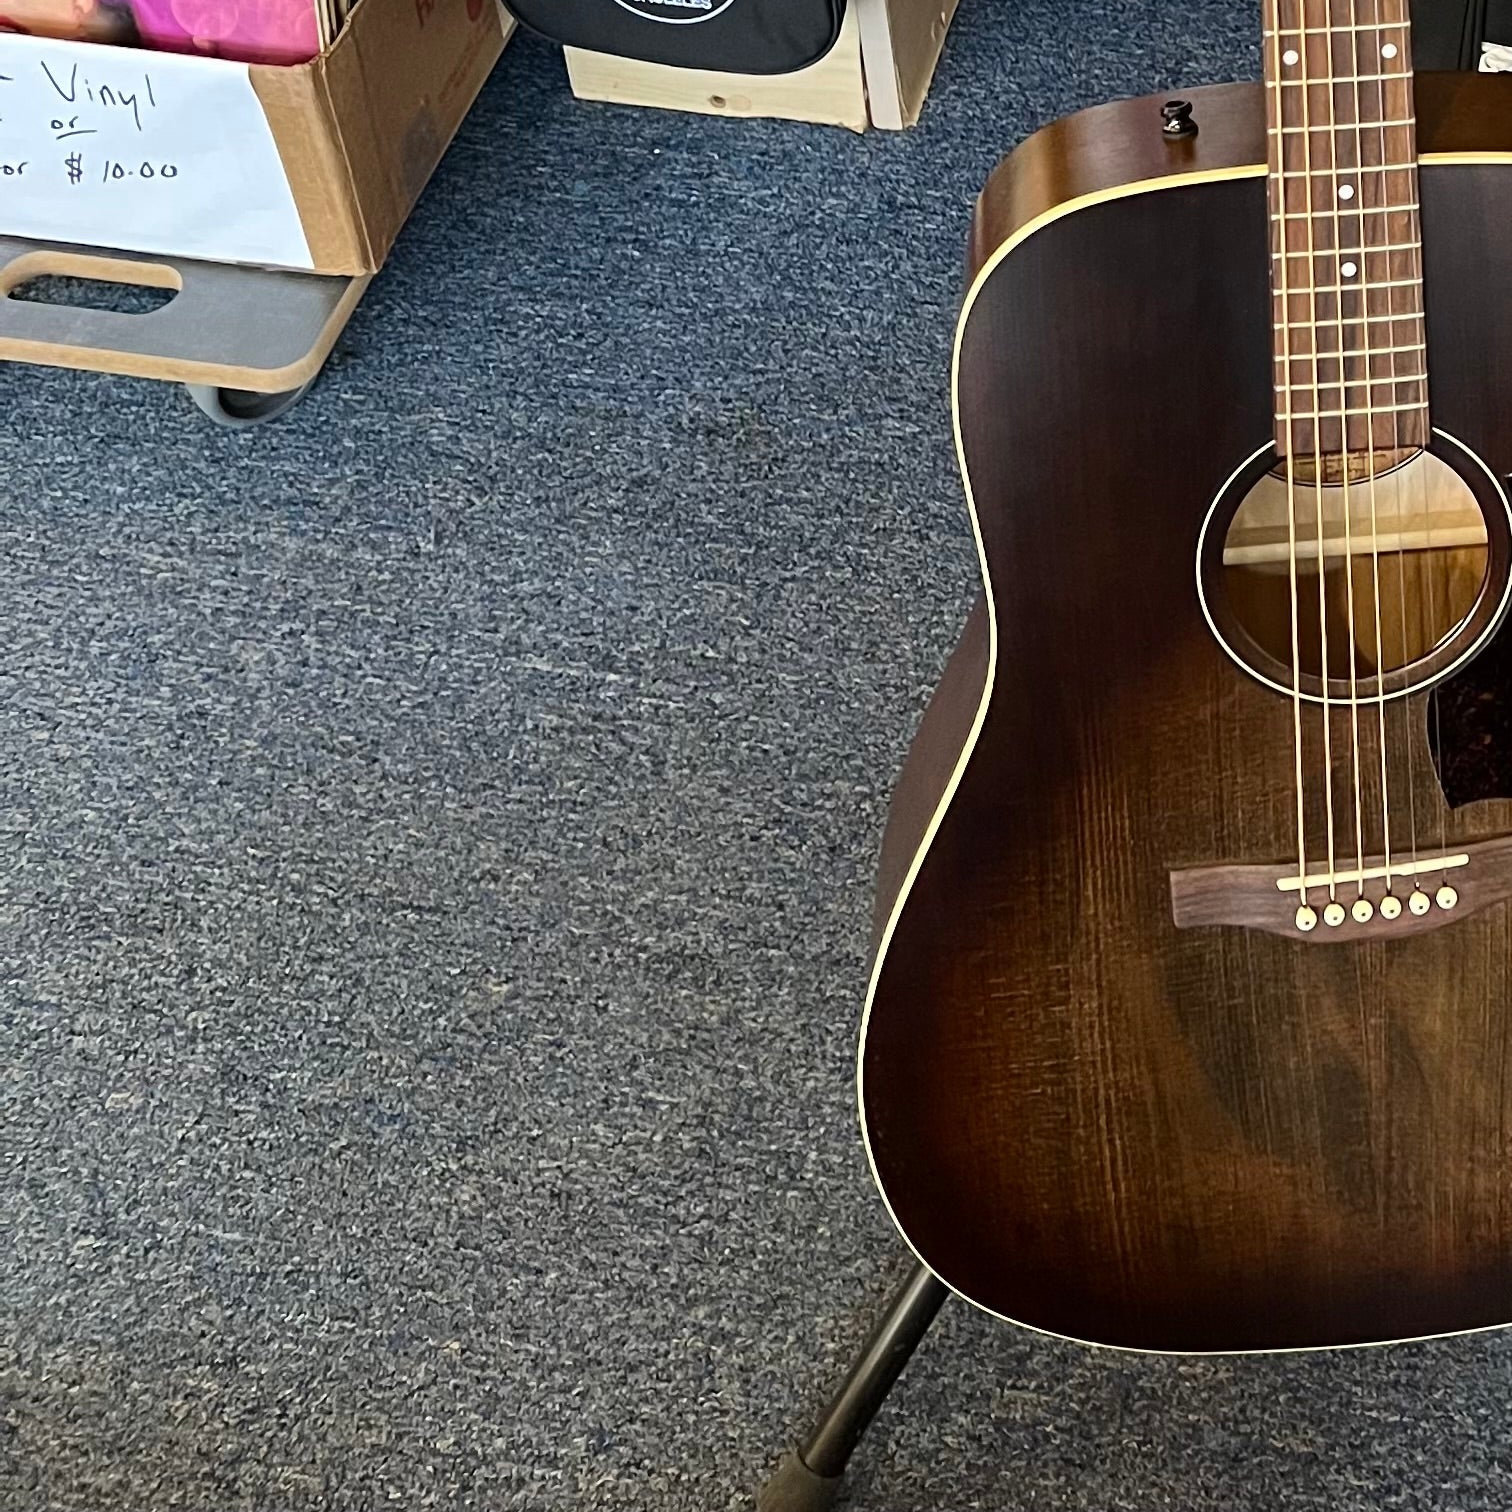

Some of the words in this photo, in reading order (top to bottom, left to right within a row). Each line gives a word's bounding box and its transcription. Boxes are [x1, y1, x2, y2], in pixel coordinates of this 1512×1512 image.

[40, 60, 156, 132] Vinyl
[50, 115, 79, 130] or
[0, 161, 29, 176] or
